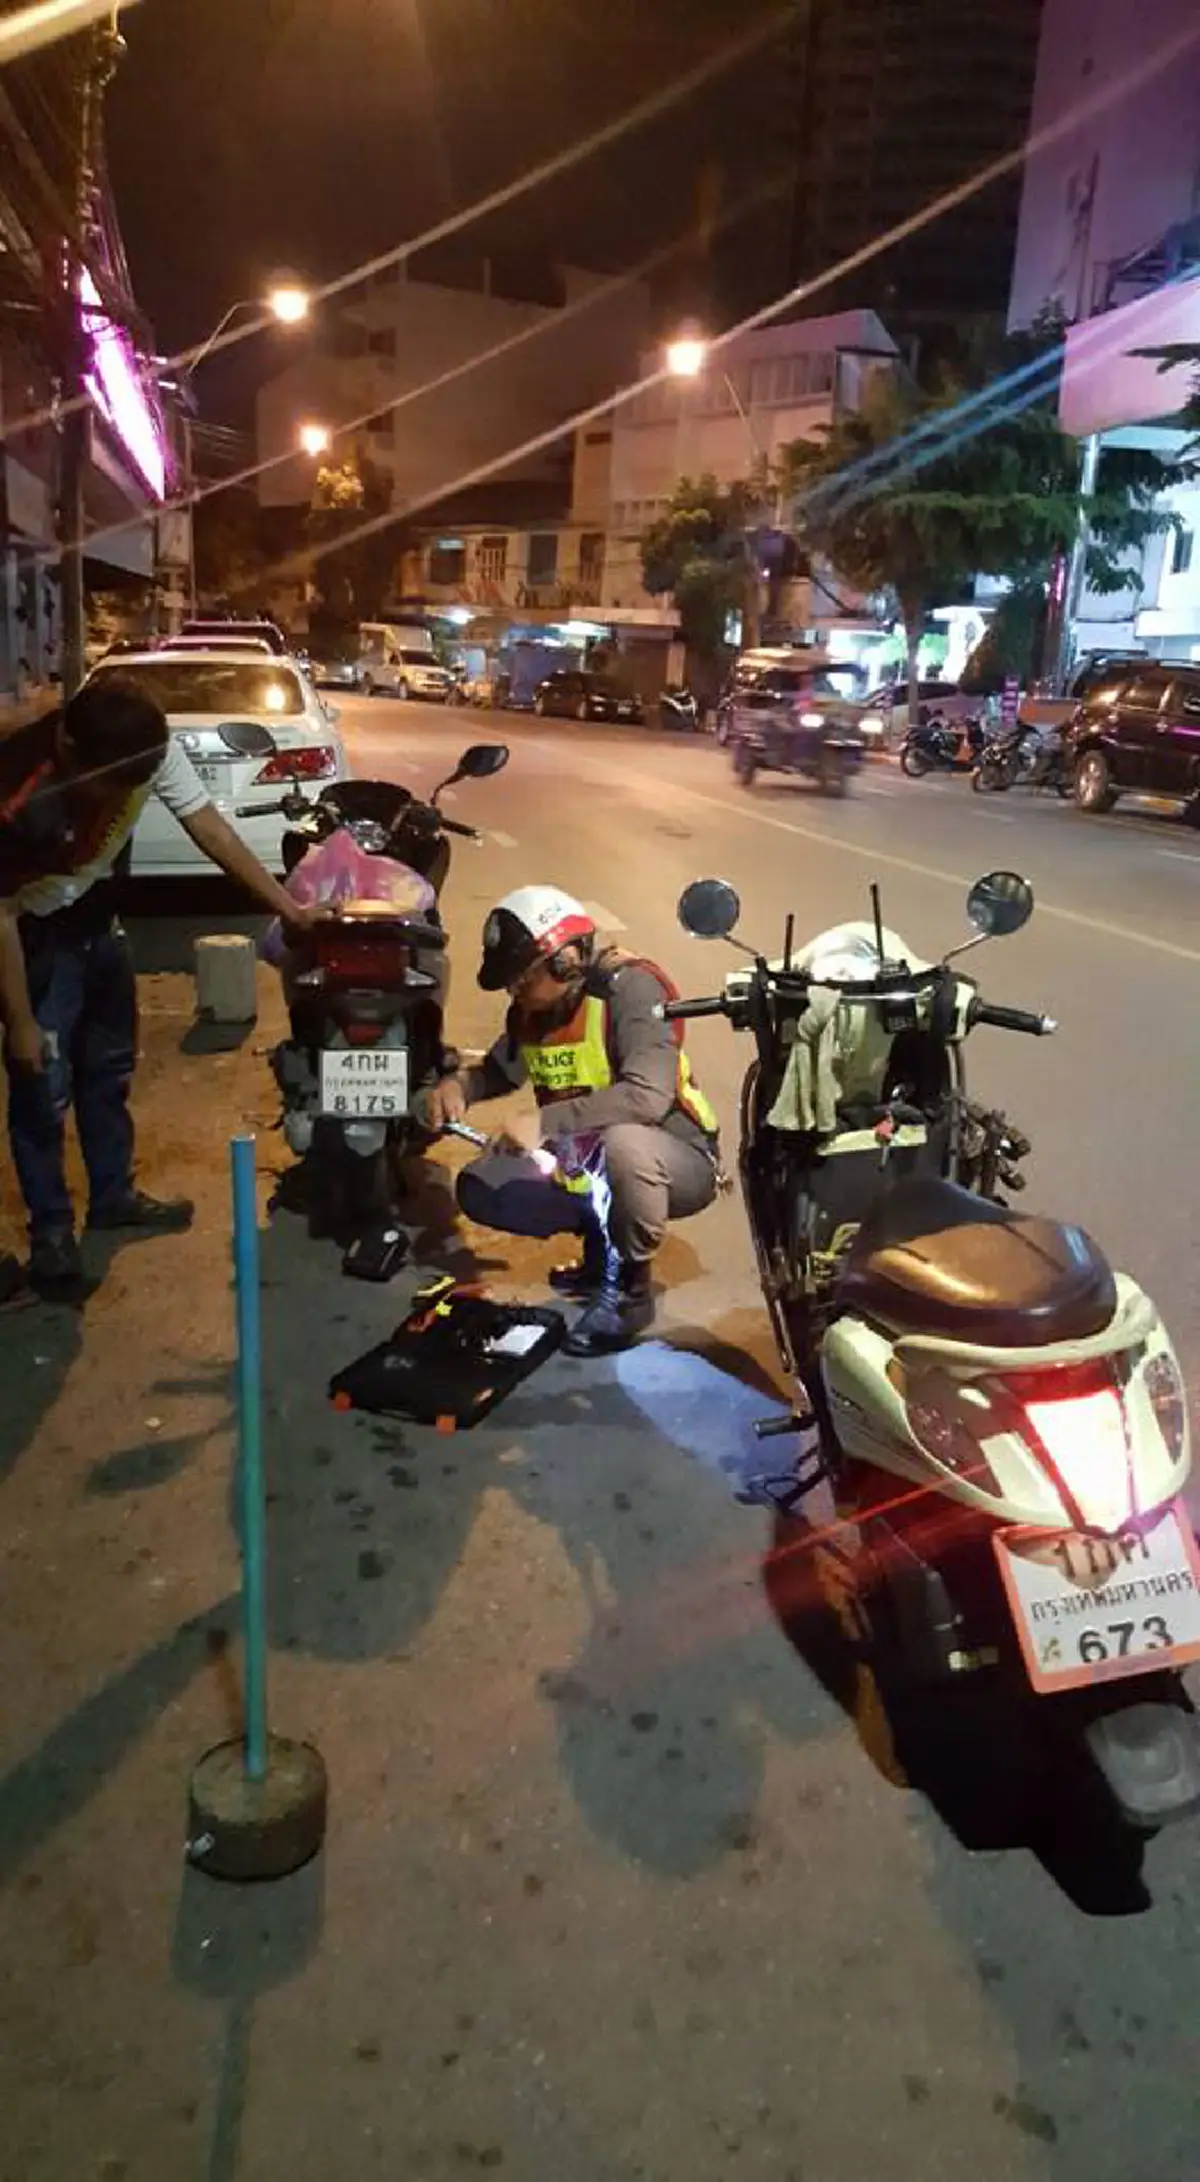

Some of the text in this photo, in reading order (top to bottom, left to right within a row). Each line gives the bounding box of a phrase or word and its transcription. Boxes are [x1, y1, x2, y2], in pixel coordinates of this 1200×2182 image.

[334, 1095, 397, 1114] 8175
[1030, 1570, 1194, 1626] กรุงเทพมหานคร
[1078, 1615, 1173, 1663] 673
